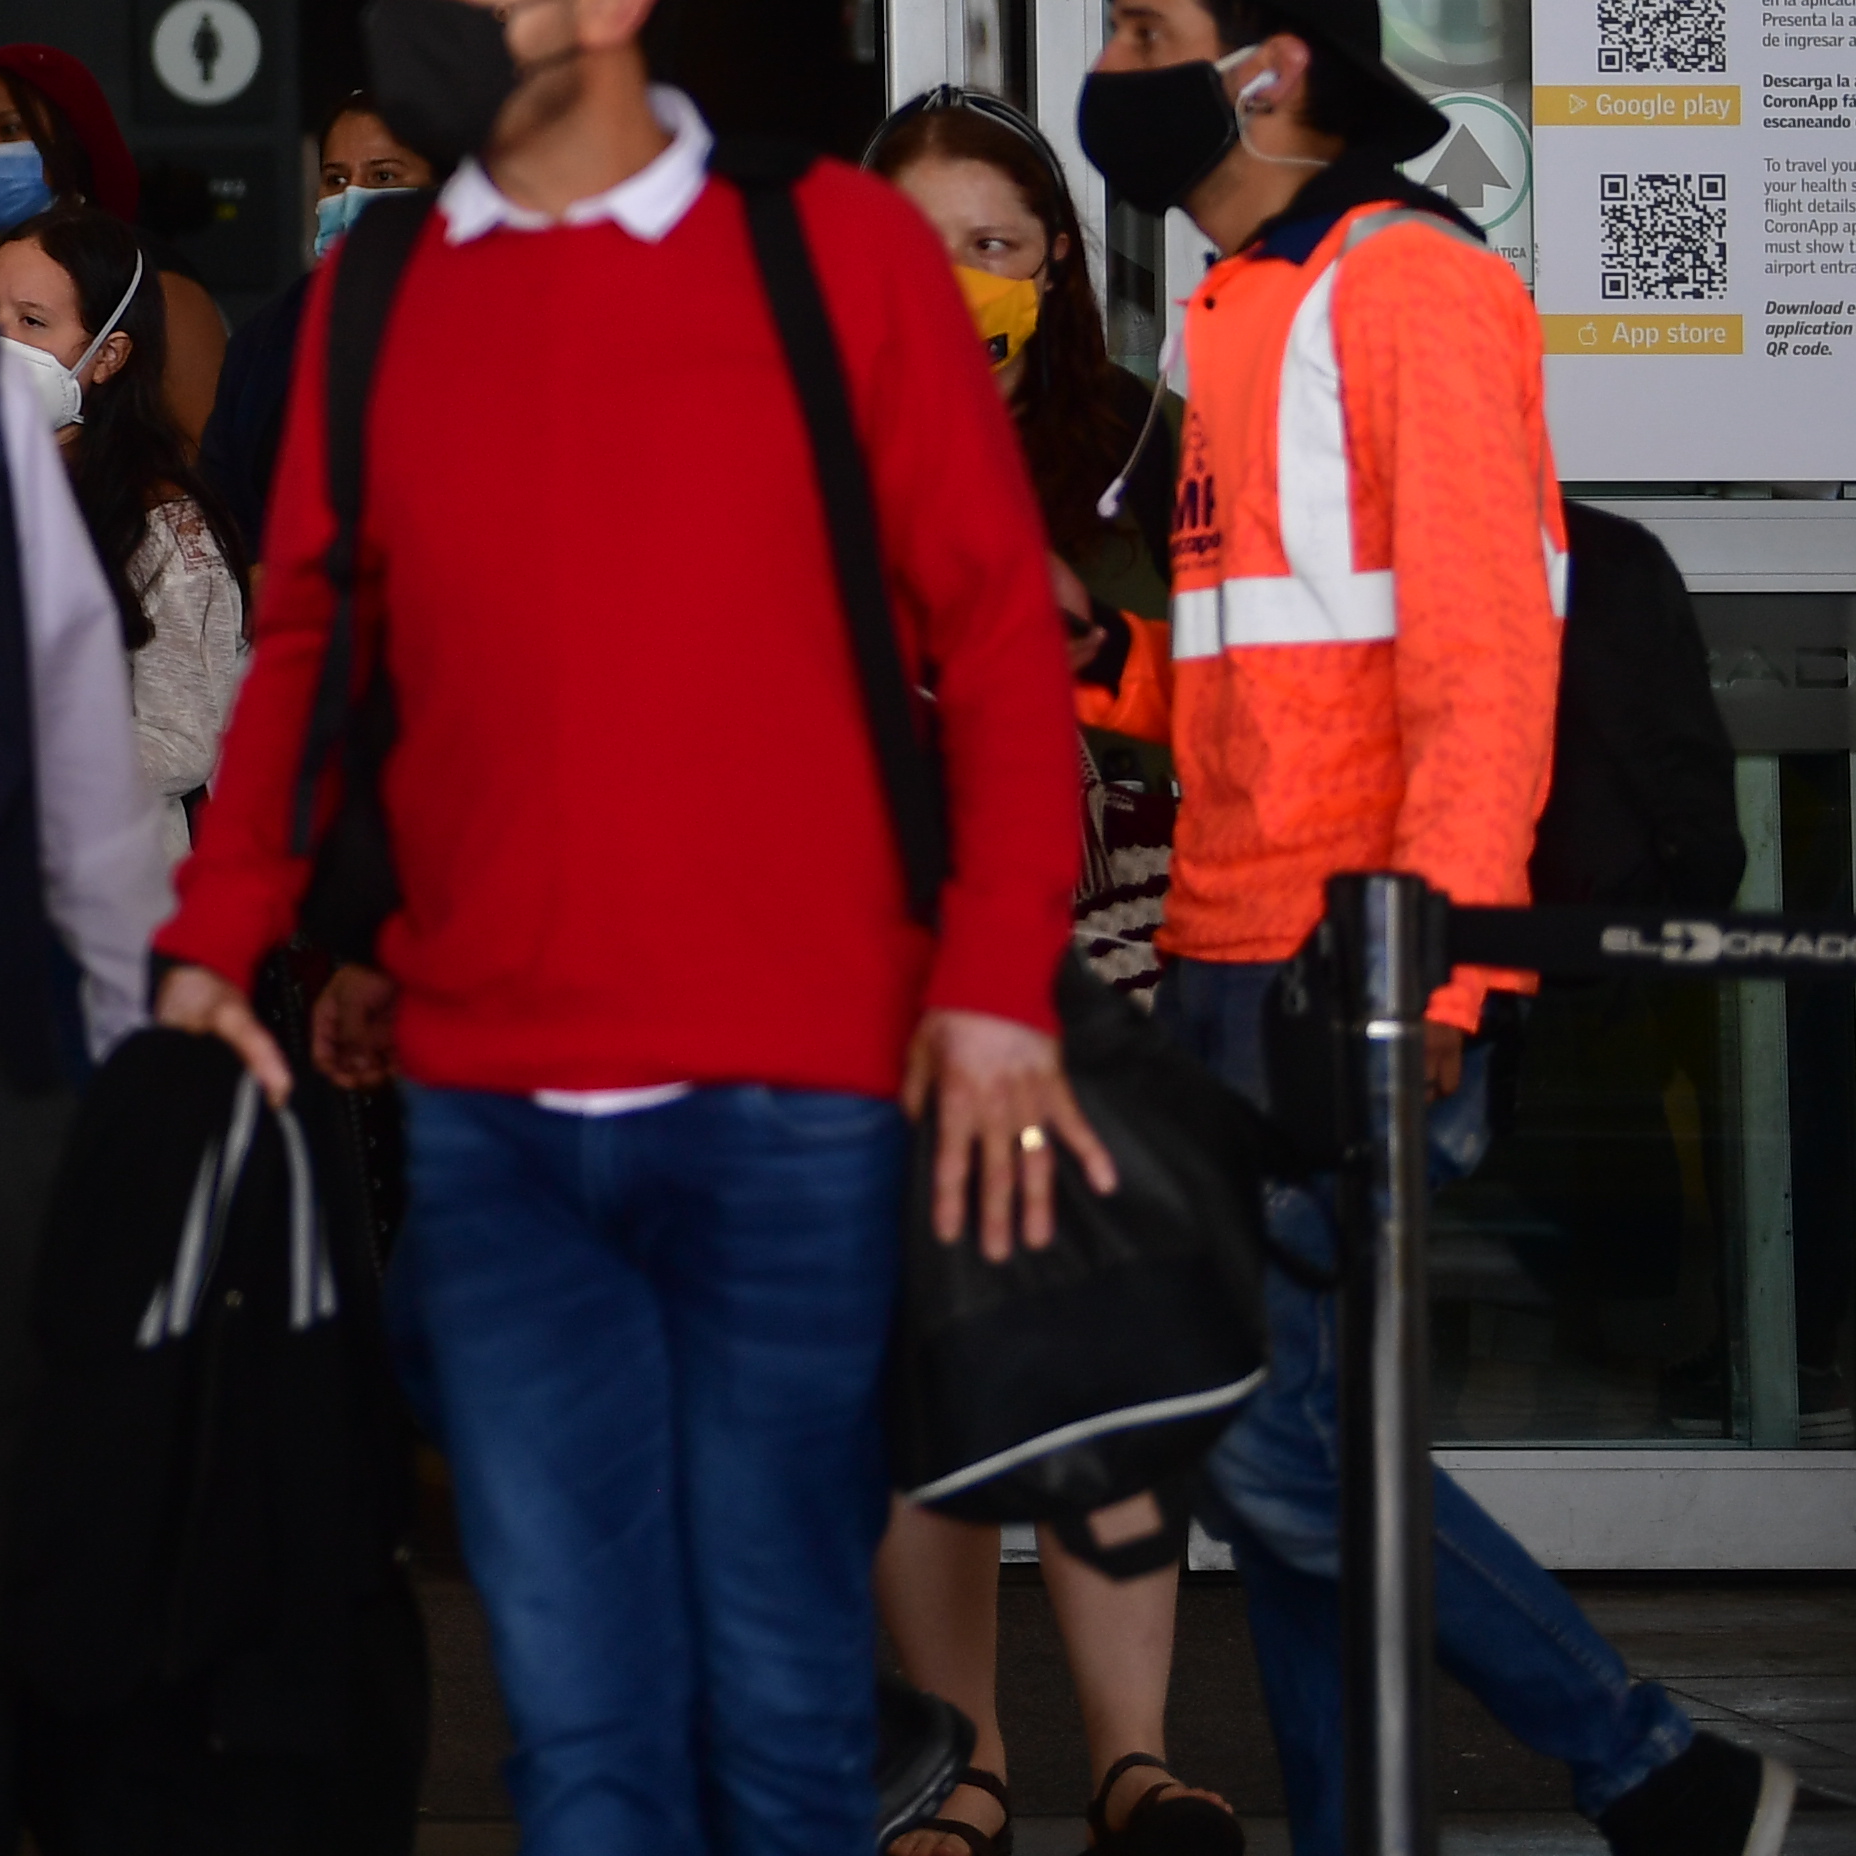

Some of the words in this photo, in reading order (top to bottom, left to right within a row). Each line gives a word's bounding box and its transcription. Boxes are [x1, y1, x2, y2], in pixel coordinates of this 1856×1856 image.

[1762, 12, 1828, 27] Presenta
[1831, 12, 1845, 27] la
[1762, 33, 1780, 48] de
[1784, 33, 1845, 51] ingresar
[1763, 73, 1833, 91] Descarga
[1837, 73, 1850, 88] la
[1595, 93, 1676, 120] Google
[1684, 93, 1732, 120] play
[1763, 94, 1838, 112] CoronApp
[1763, 114, 1851, 129] escaneando
[1763, 158, 1781, 173] To
[1785, 158, 1827, 173] travel
[1763, 182, 1797, 197] your
[1801, 178, 1847, 193] health
[1764, 198, 1804, 217] flight
[1807, 198, 1856, 214] details
[1764, 219, 1839, 237] CoronApp
[1490, 245, 1527, 259] ÁTICA
[1764, 239, 1802, 254] must
[1805, 239, 1845, 254] show
[1764, 260, 1816, 278] airport
[1764, 301, 1845, 316] Download
[1612, 322, 1660, 349] App
[1668, 322, 1726, 344] store
[1764, 321, 1854, 339] application
[1766, 341, 1789, 357] QR
[1791, 341, 1834, 357] code.
